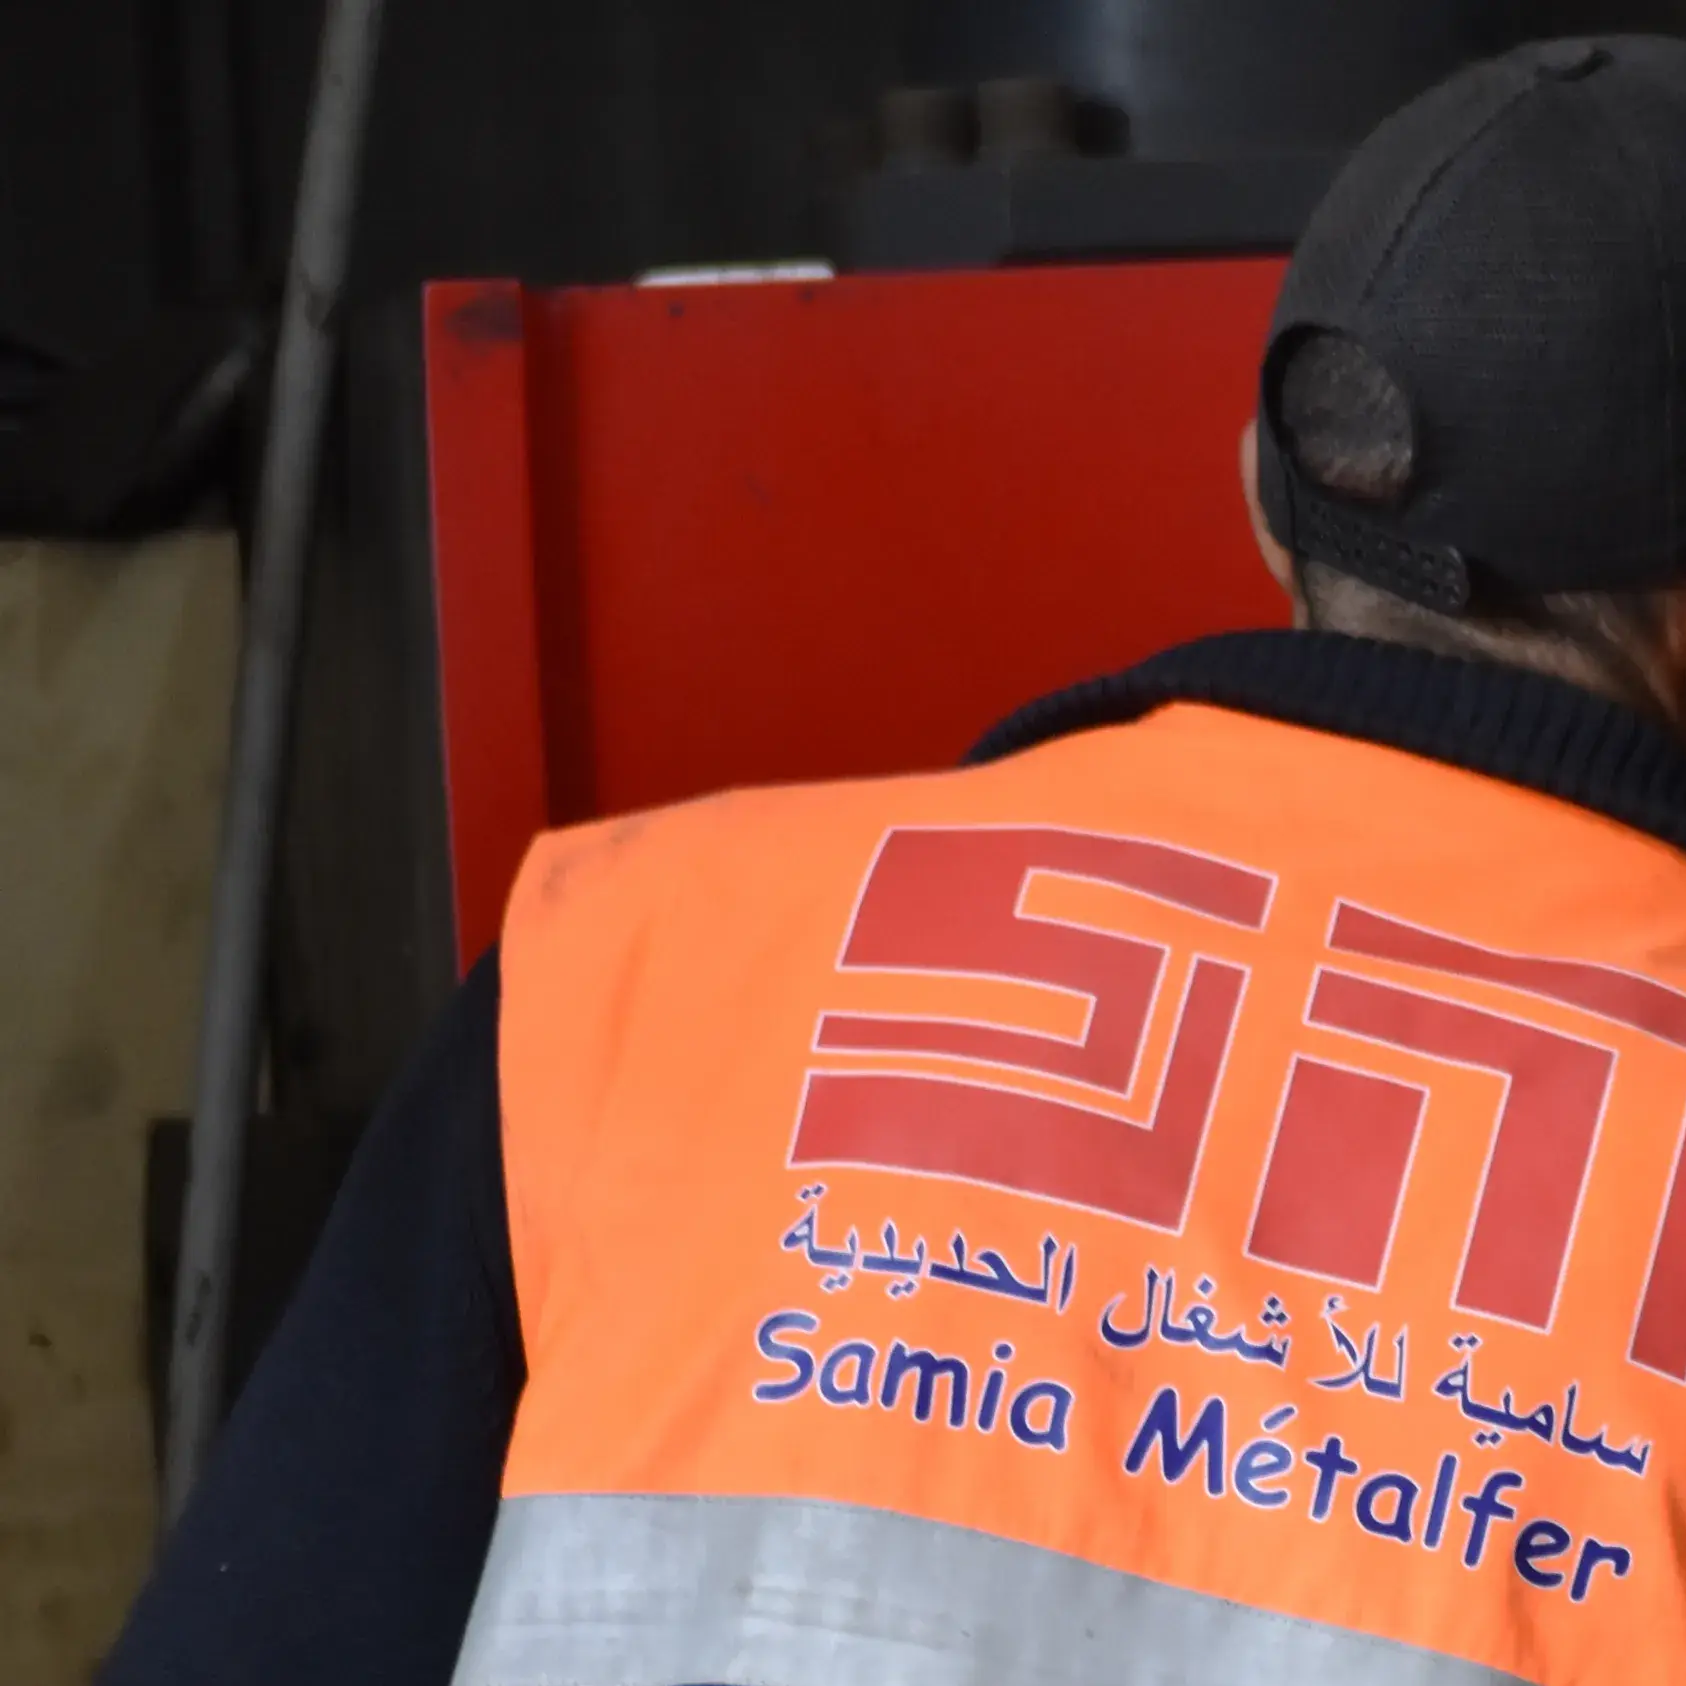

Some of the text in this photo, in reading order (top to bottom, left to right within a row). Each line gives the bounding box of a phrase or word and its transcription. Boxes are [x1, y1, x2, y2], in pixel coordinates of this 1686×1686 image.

[781, 1184, 1077, 1313] الحديدية
[753, 1310, 1632, 1603] Samia Métalfer
[1432, 1332, 1651, 1476] سامية
